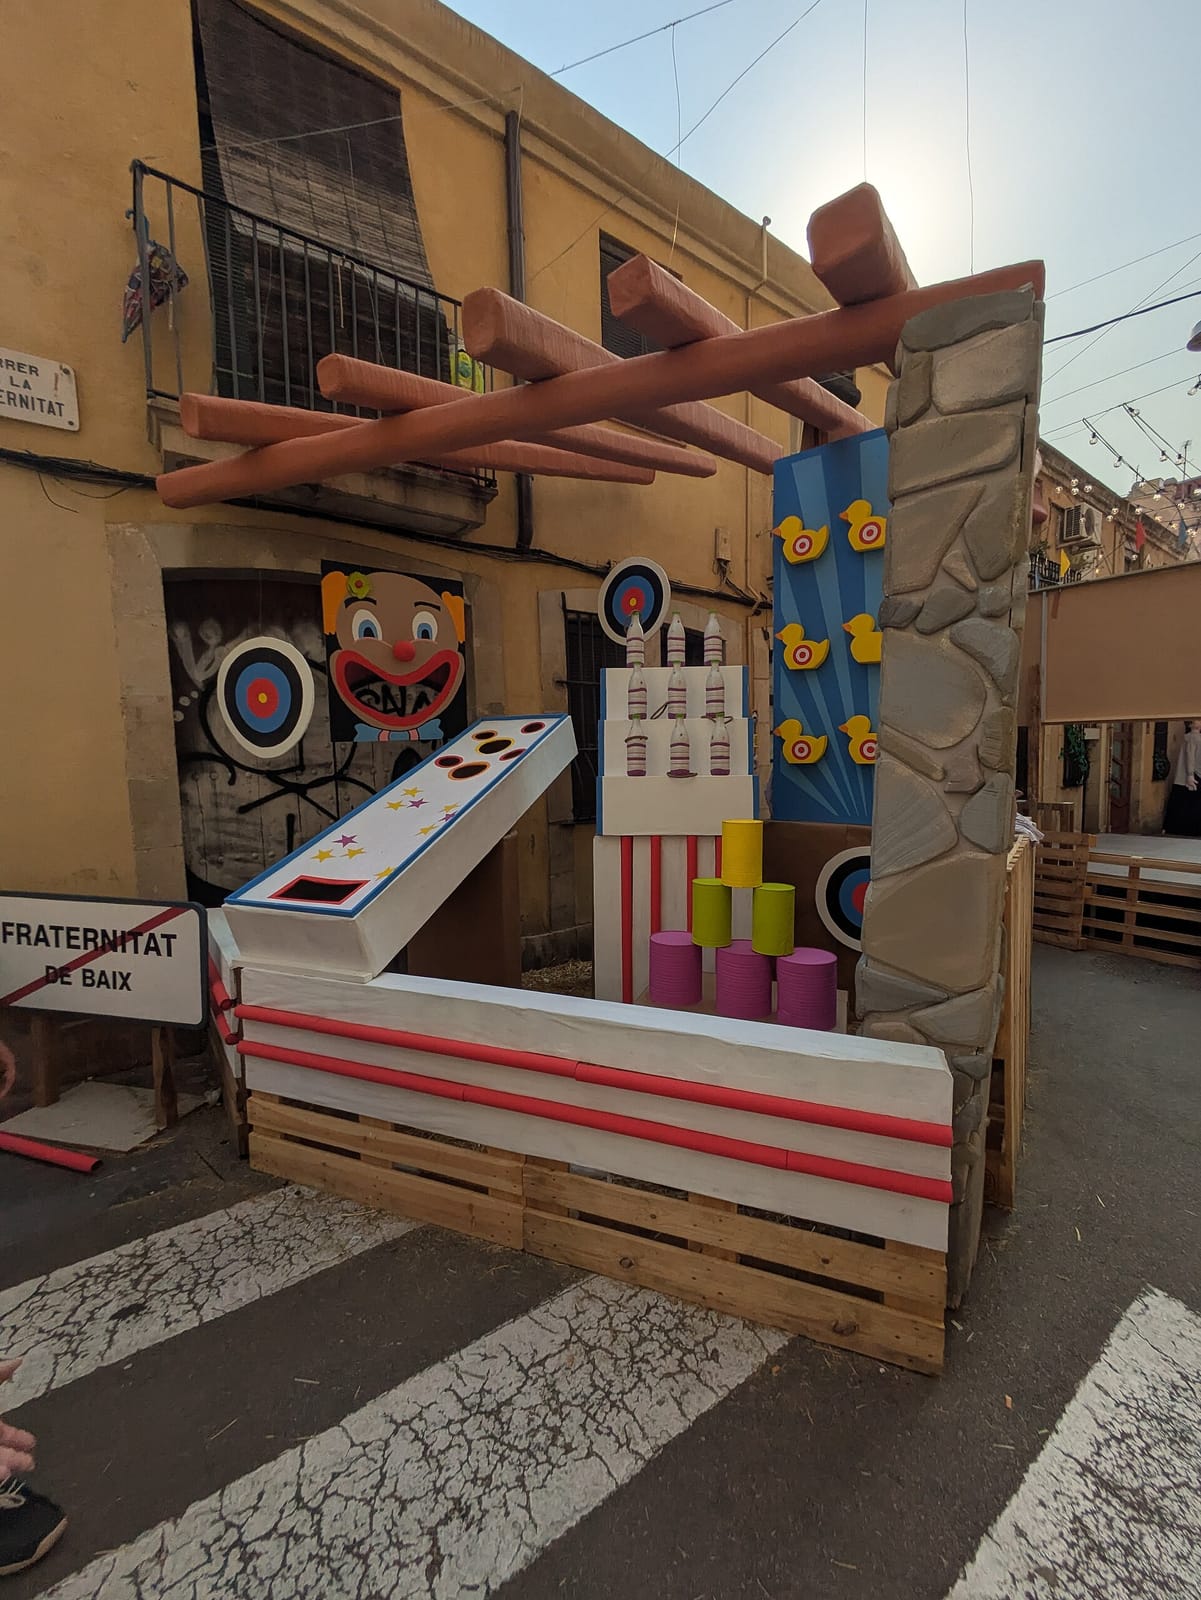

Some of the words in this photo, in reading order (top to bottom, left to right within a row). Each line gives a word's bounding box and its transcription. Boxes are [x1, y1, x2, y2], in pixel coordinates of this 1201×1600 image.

[10, 376, 32, 390] LA
[2, 921, 177, 958] FRATERNITAT
[45, 965, 73, 986] DE
[81, 968, 133, 992] BAIX
